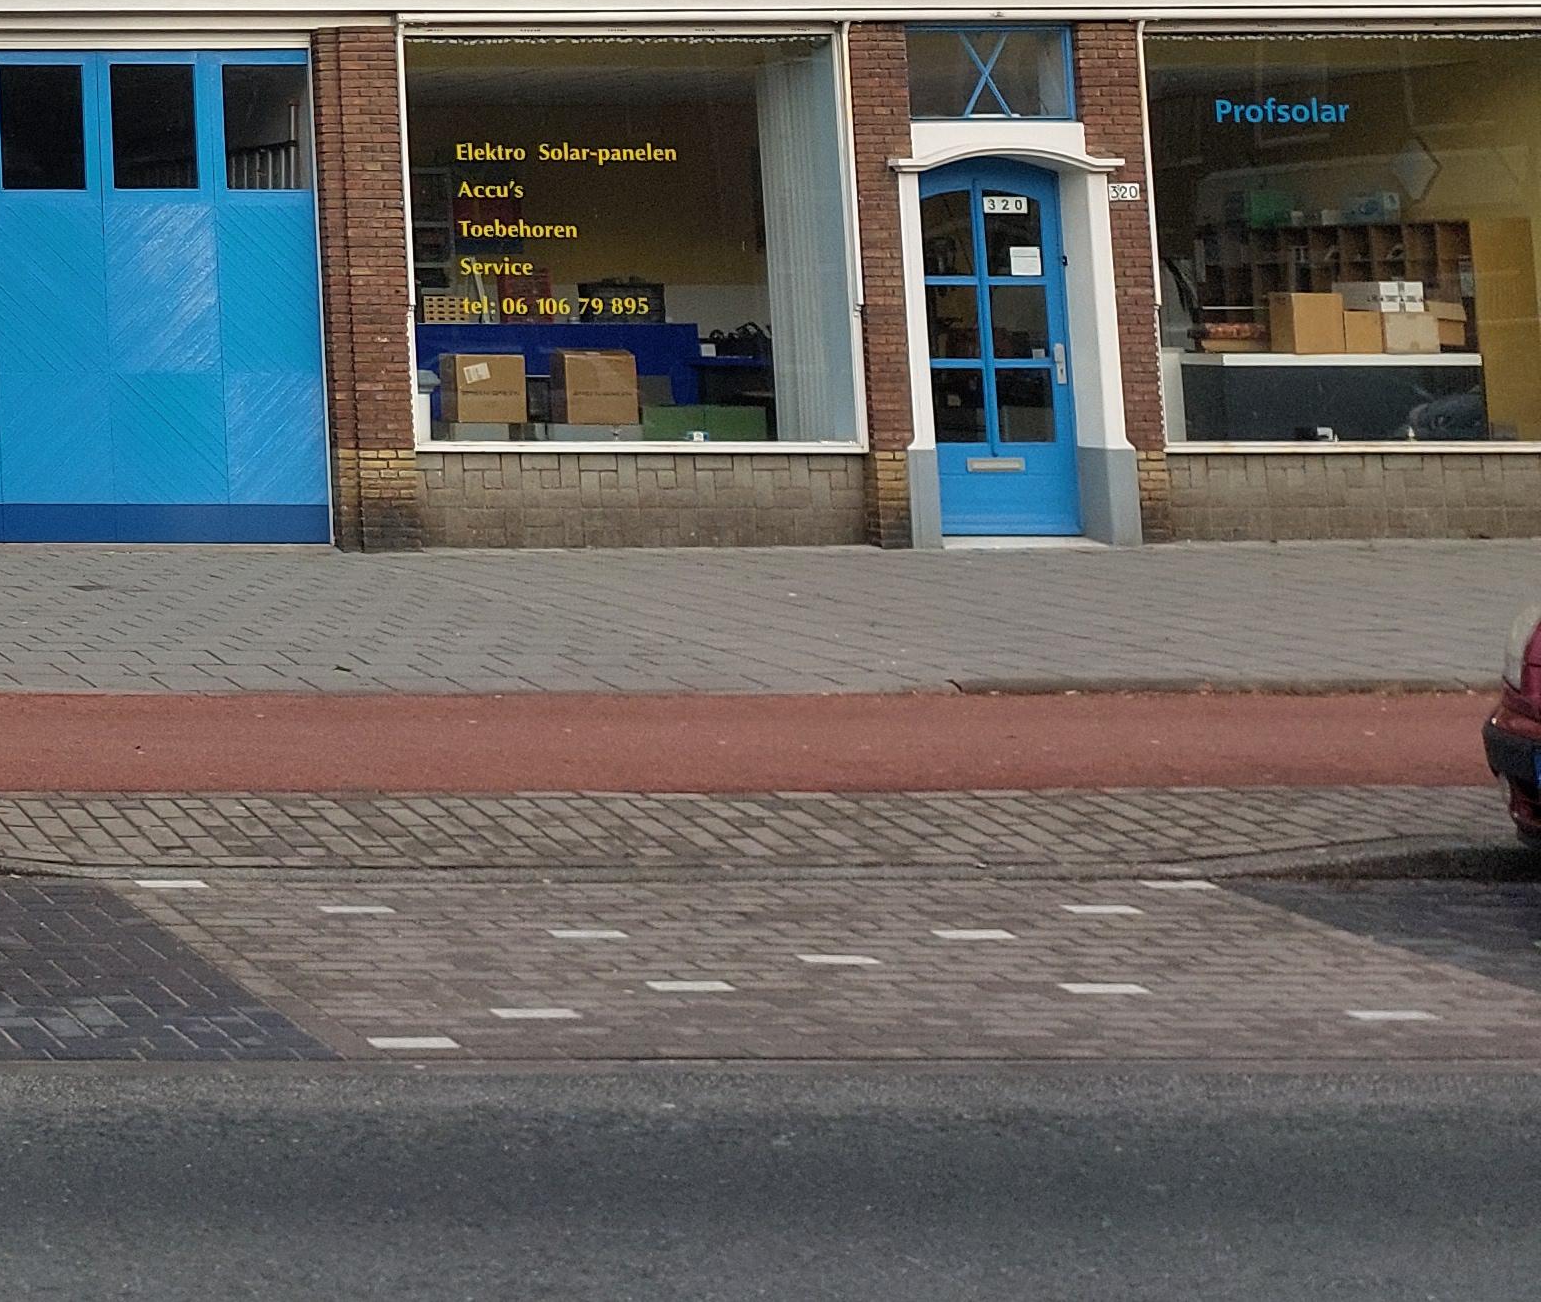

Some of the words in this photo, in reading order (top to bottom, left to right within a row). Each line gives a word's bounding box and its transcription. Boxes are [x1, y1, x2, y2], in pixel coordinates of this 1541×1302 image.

[1215, 96, 1350, 123] Profsolar
[455, 142, 526, 161] Elektro
[538, 142, 677, 166] Solar-panelen
[457, 180, 524, 198] Accu's
[1110, 185, 1138, 199] 320
[987, 199, 1023, 211] 320
[458, 219, 578, 238] Toebehoren
[460, 257, 534, 275] Service
[463, 295, 496, 315] tel:
[502, 298, 528, 315] 06
[536, 298, 571, 315] 106
[578, 298, 603, 315] 79
[611, 298, 649, 315] 895
